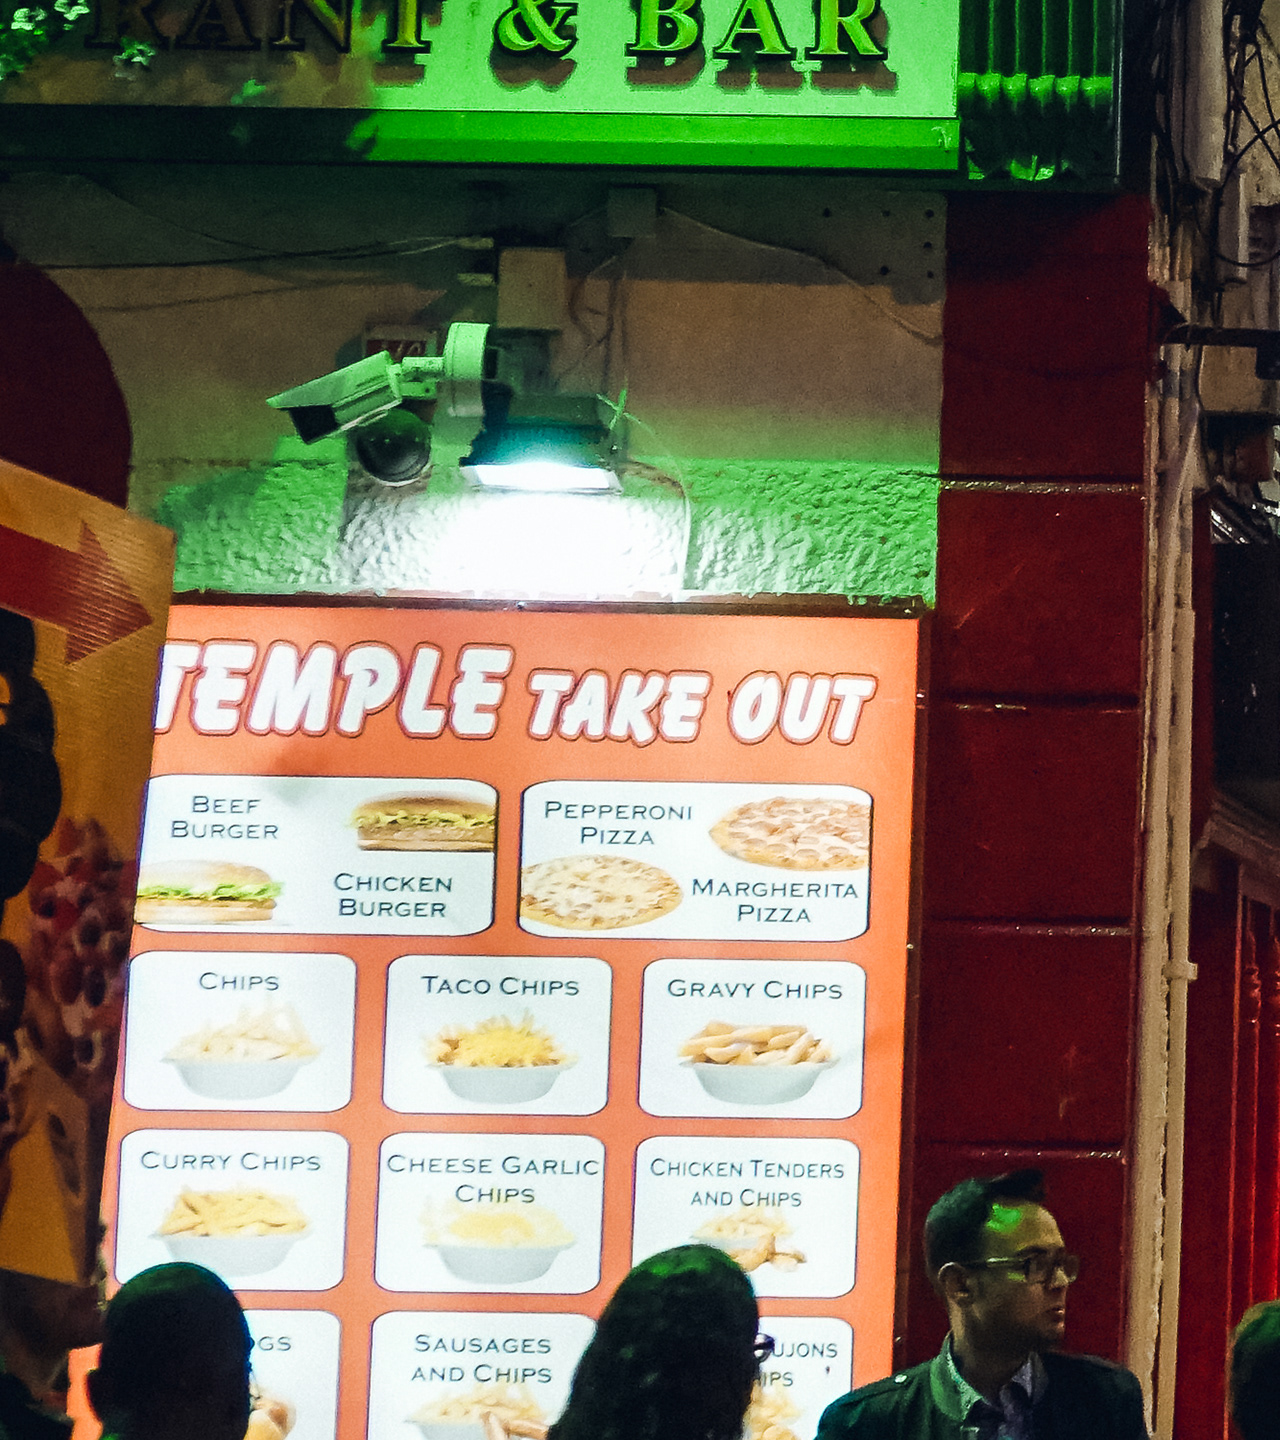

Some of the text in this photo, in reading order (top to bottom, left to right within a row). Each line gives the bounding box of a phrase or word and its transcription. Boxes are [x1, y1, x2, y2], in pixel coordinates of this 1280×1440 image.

[154, 638, 879, 746] TEMPLE TAKE OUT
[190, 795, 261, 815] BEEF
[543, 799, 693, 823] PEPPERONI
[170, 818, 279, 841] BURGER
[578, 825, 655, 847] PIZZA
[333, 872, 453, 895] CHICKEN
[690, 877, 859, 901] MARGHERITA
[337, 897, 447, 919] BURGER
[735, 902, 812, 924] PIZZA
[197, 971, 280, 993] CHIPS
[420, 974, 580, 997] TACO CHIPS
[666, 978, 843, 1000] GRAVY CHIPS
[139, 1151, 322, 1173] CURRY CHIPS
[385, 1153, 601, 1176] CHEESE GARLIC
[649, 1157, 846, 1180] CHICKEN TENDERS
[454, 1183, 537, 1205] CHIPS
[690, 1188, 803, 1208] AND CHIPS
[250, 1336, 292, 1352] GS
[414, 1333, 552, 1355] SAUSAGES
[770, 1342, 839, 1359] UJONS
[411, 1363, 553, 1384] AND CHIPS
